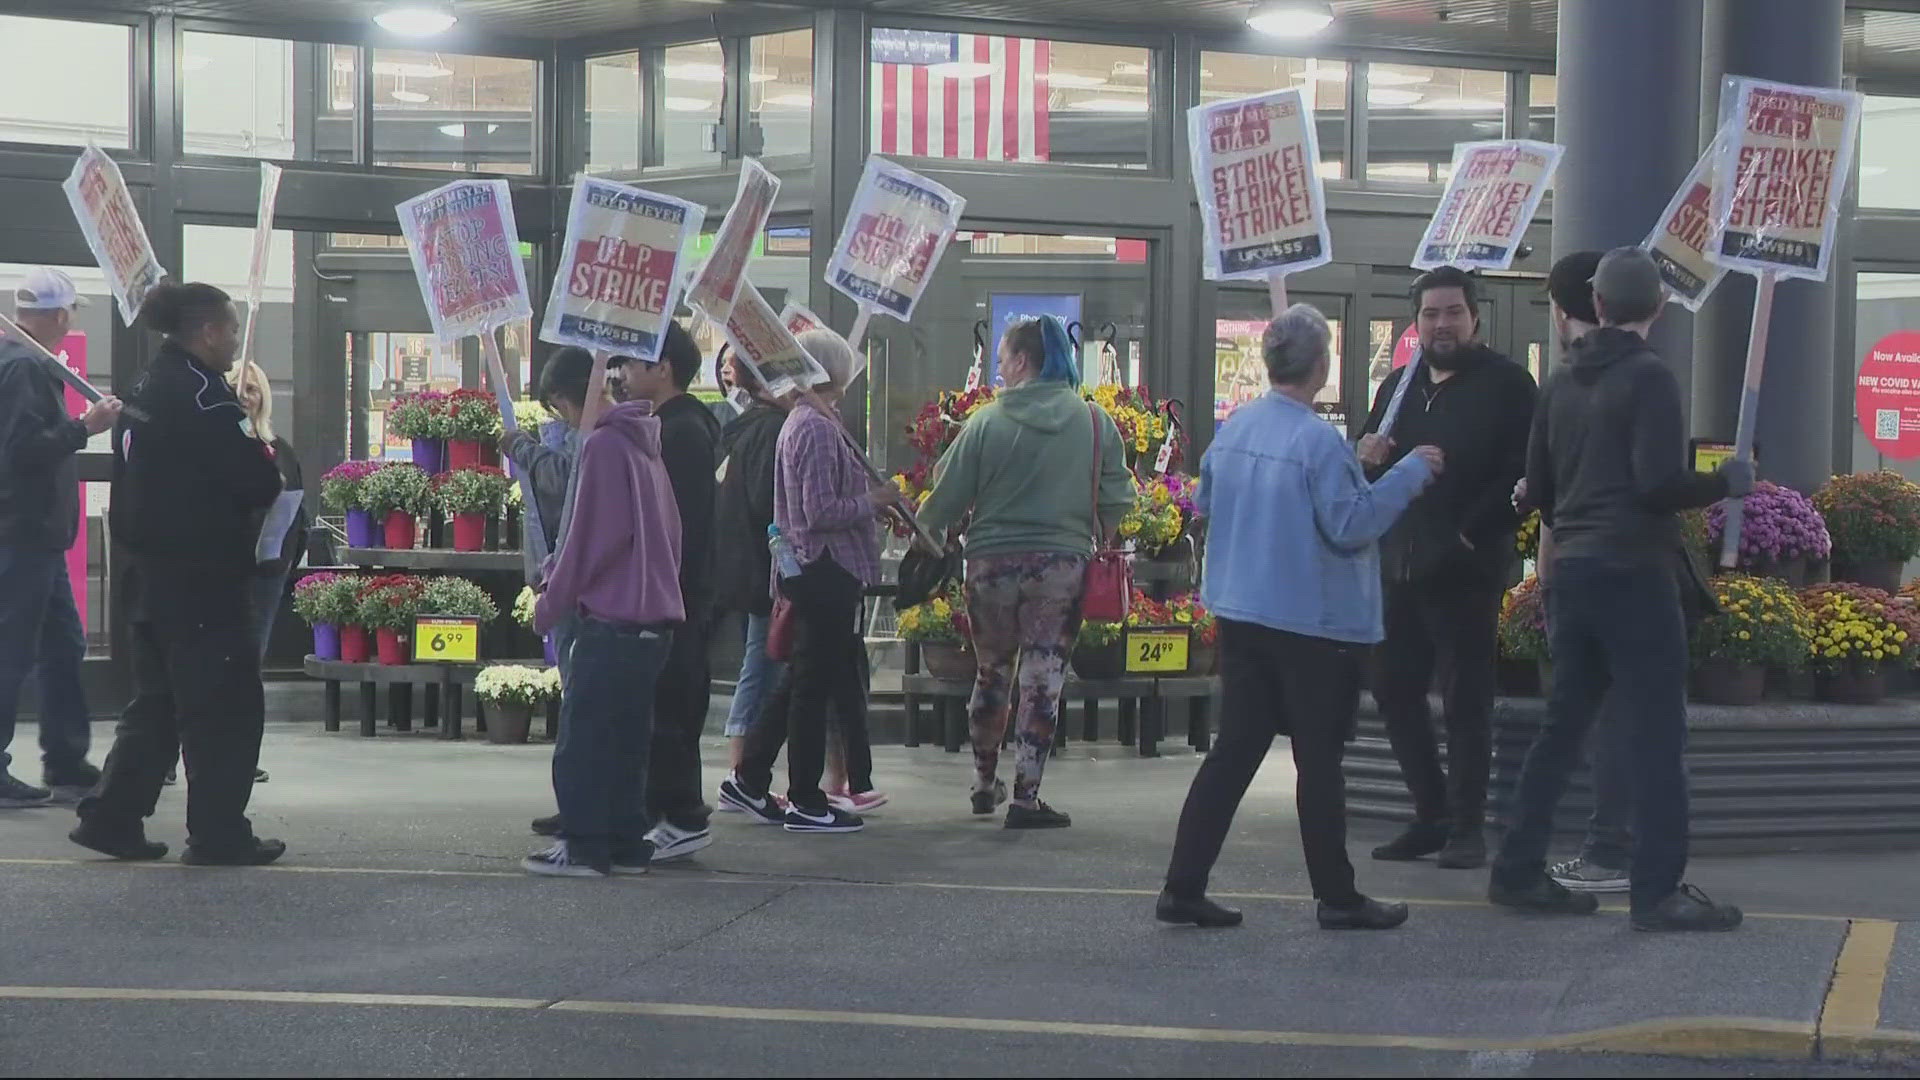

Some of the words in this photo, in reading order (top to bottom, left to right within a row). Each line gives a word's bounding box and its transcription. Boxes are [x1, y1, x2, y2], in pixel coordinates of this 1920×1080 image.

[1748, 92, 1790, 110] FRED
[1792, 99, 1845, 121] MEYER
[1213, 143, 1303, 194] STRIKE!
[1737, 147, 1836, 176] STRIKE!
[1215, 167, 1307, 218] STRIKE!
[1732, 172, 1831, 202] STRIKE!
[591, 193, 629, 212] FRED
[629, 203, 683, 225] MEYER
[1218, 192, 1313, 245] STRIKE!
[1729, 199, 1826, 229] STRIKE!
[596, 235, 653, 274] U.L.P.
[848, 230, 928, 284] STRIE
[570, 263, 666, 316] STRIKE
[1020, 313, 1067, 323] Phacy
[1873, 351, 1893, 361] Now
[1859, 376, 1879, 386] NEW
[1880, 377, 1909, 389] COVID
